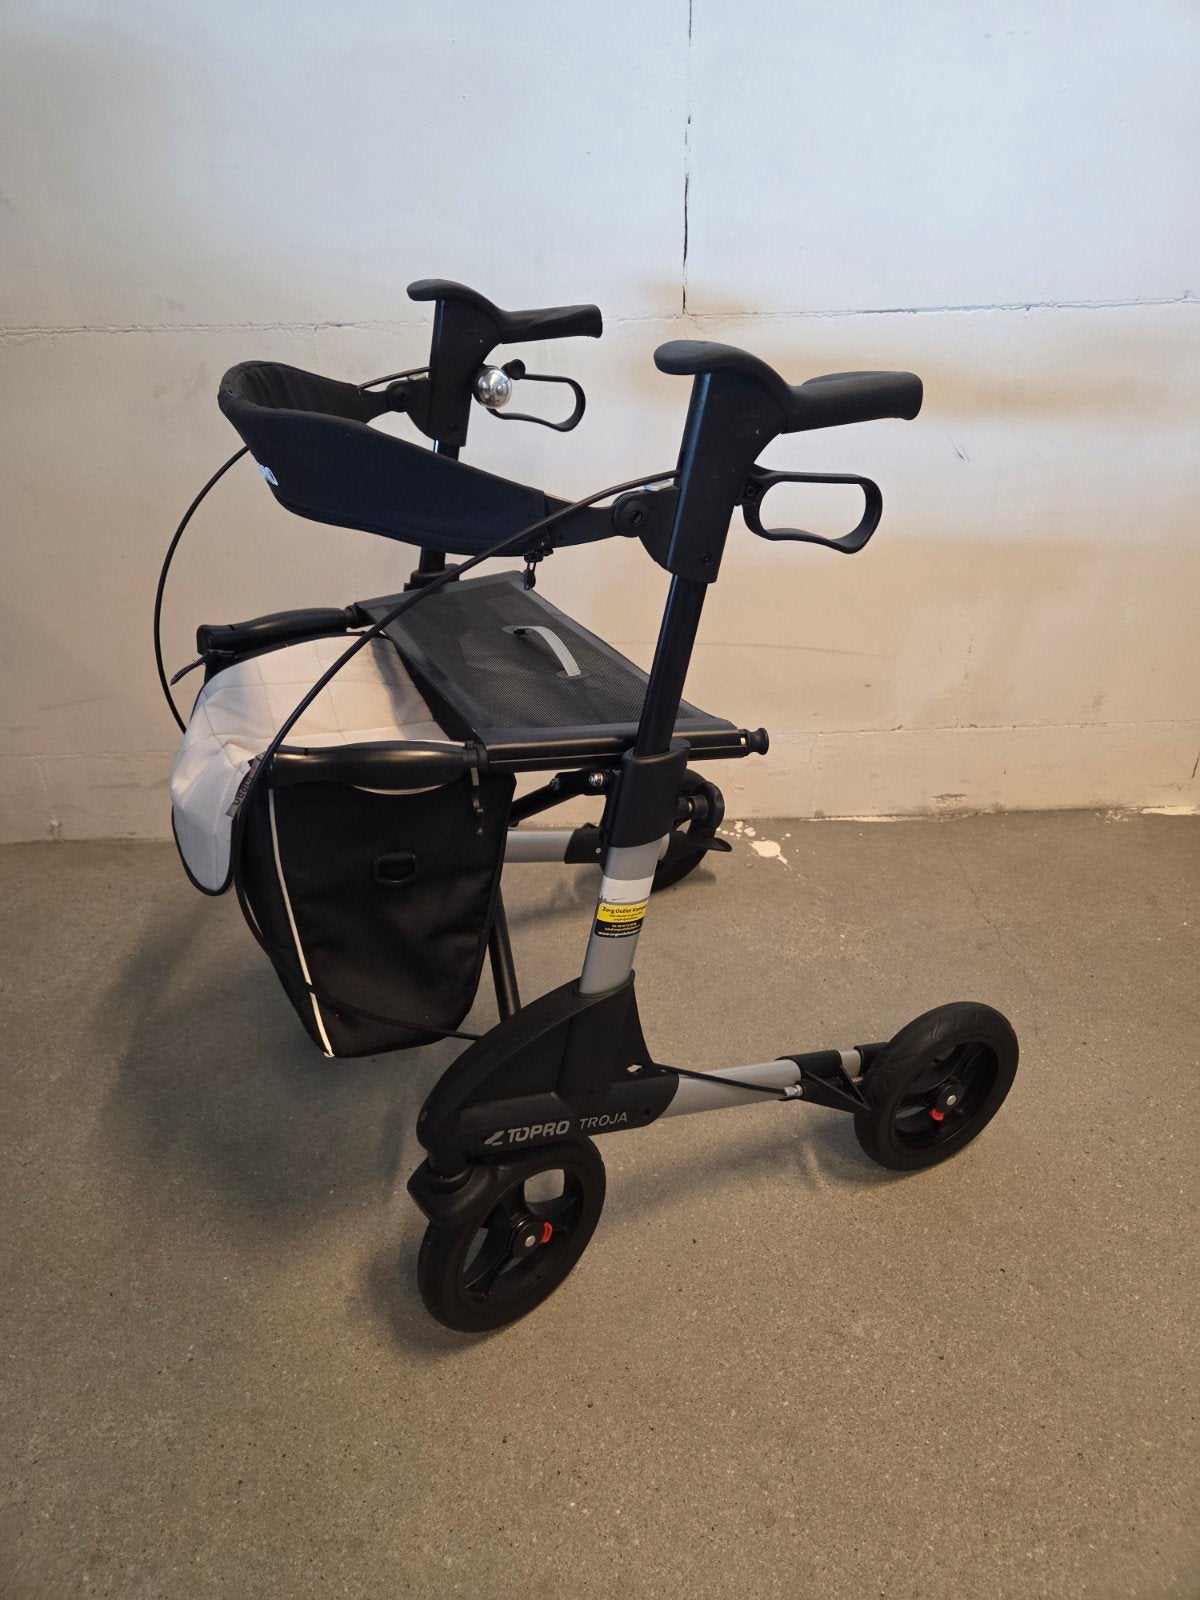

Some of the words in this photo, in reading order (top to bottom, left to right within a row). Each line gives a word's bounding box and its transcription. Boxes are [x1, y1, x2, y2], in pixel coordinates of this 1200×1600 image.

[602, 906, 615, 915] Zorg
[507, 1120, 570, 1143] TOPRO
[579, 1111, 628, 1130] TROJA
